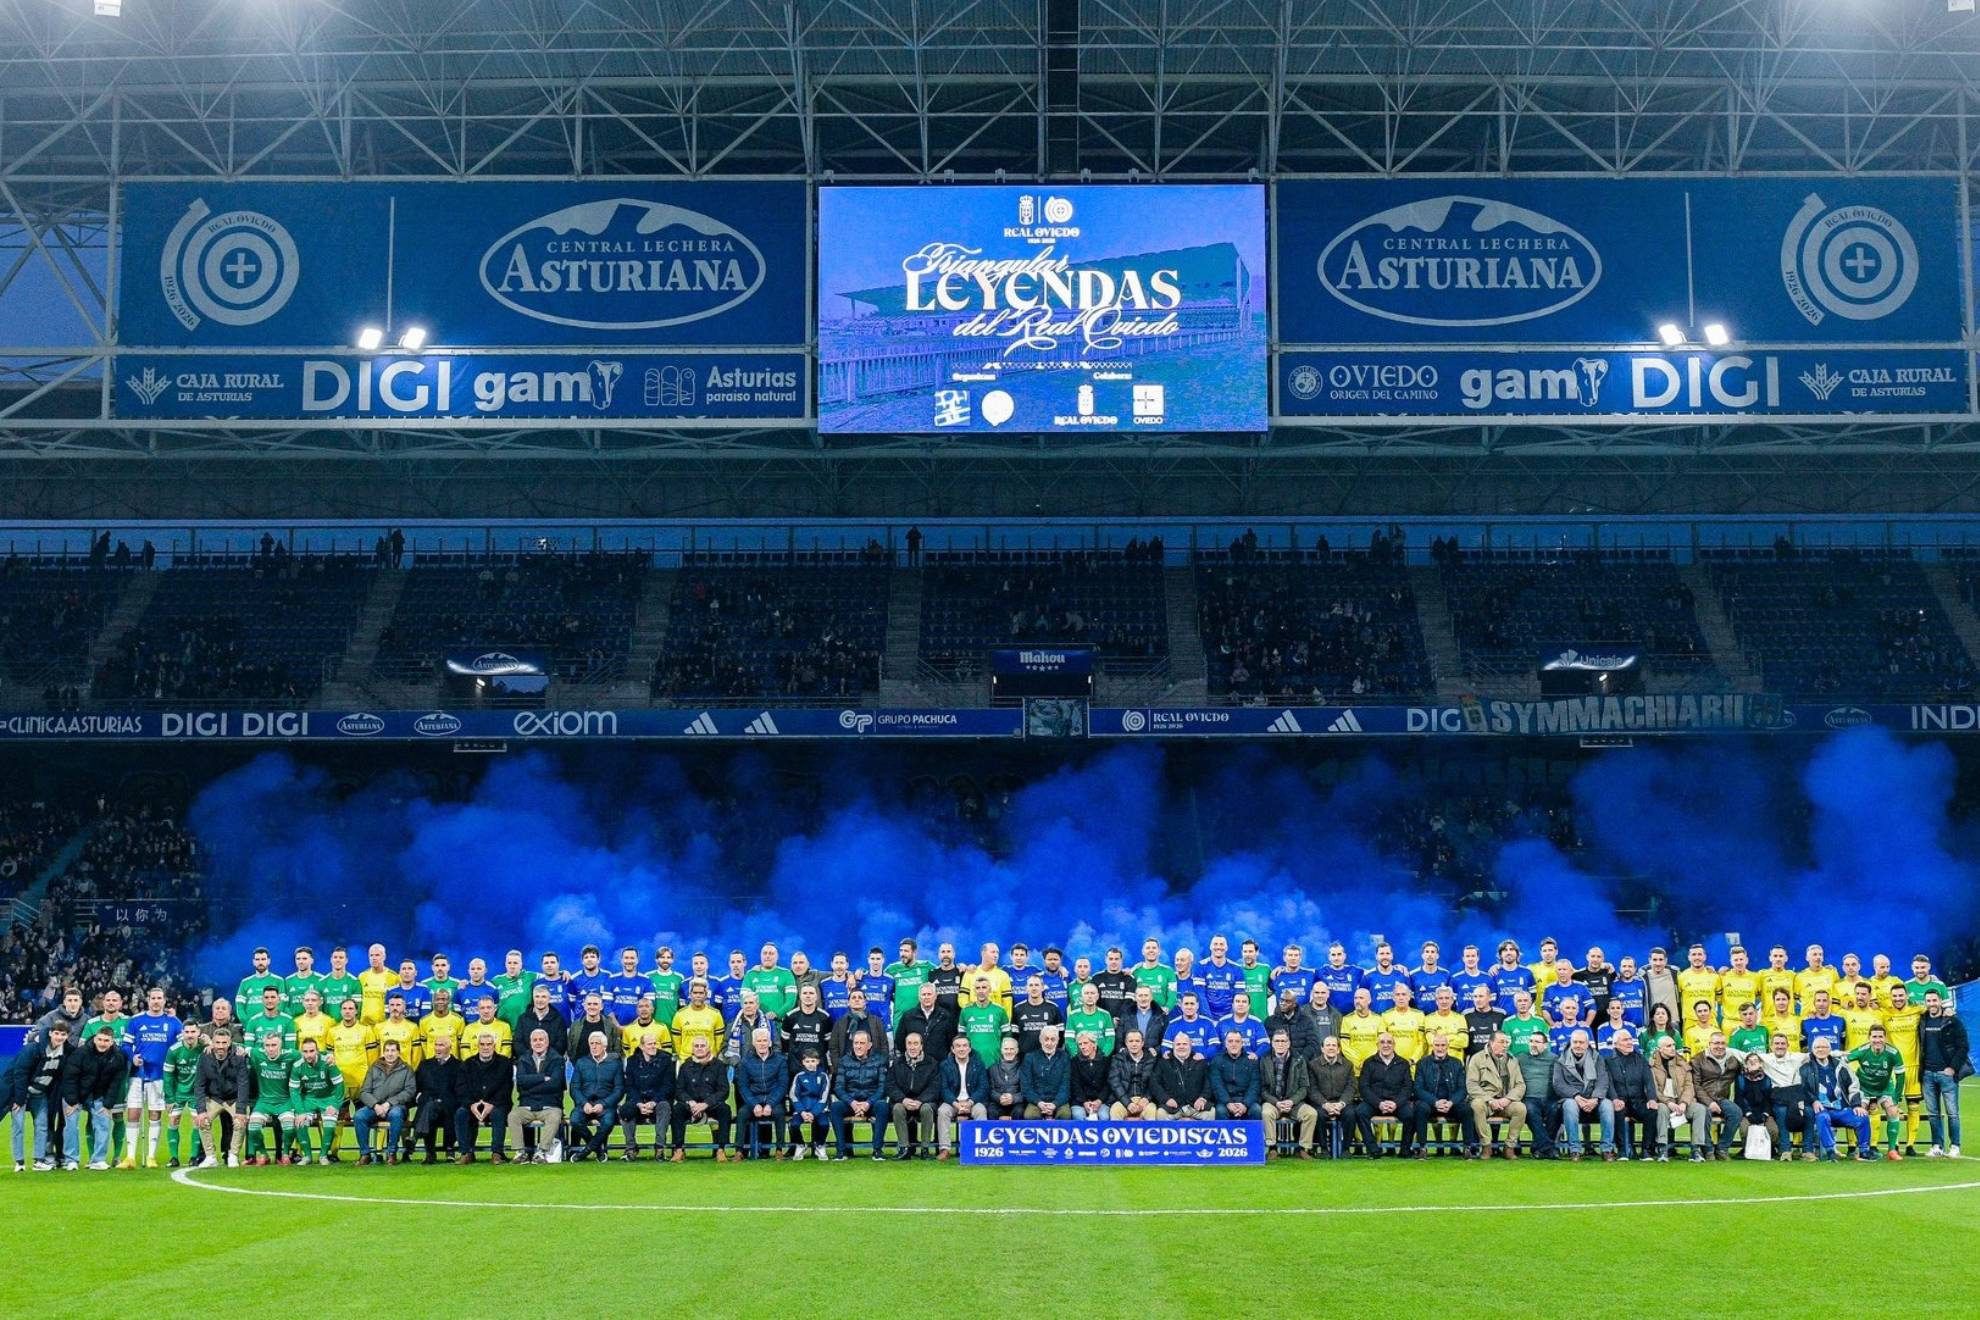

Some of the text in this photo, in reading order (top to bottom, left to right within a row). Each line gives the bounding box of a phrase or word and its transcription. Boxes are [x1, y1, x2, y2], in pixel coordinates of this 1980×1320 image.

[208, 214, 277, 233] REAL OVIEDO
[1824, 209, 1893, 229] REAL OVIEDO
[1003, 227, 1080, 237] REAL OVIEDO
[547, 240, 735, 253] CENTRAL LECHERA
[1383, 238, 1571, 250] CENTRAL LECHERA
[497, 243, 749, 293] ASTURIANA
[903, 242, 1070, 276] Triangular
[1336, 239, 1585, 290] ASTURIANA
[905, 269, 1183, 311] LEYENDAS
[173, 303, 195, 327] 2026
[1797, 298, 1819, 321] 2026
[953, 309, 1008, 337] del
[1080, 306, 1180, 355] Oviedo
[176, 373, 284, 388] CAJA RURAL
[302, 360, 451, 412] DIGI
[706, 365, 797, 388] Asturias
[1329, 365, 1439, 388] OVIEDO
[1631, 356, 1780, 408] DIGI
[1848, 367, 1957, 384] CAJA RURAL
[178, 392, 252, 401] DE ASTURIAS
[474, 371, 592, 411] gam
[754, 390, 797, 402] natural
[1330, 390, 1438, 400] ORIGEN DEL CAMINO
[1460, 369, 1578, 409] gam
[1851, 386, 1926, 397] DE ASTURIAS
[1133, 417, 1164, 425] OVIEDO
[1019, 651, 1066, 664] Mahou
[1580, 654, 1623, 667] Unicaja
[161, 712, 228, 737] DIGI
[242, 712, 309, 737] DIGI
[513, 710, 617, 736] exiom
[877, 714, 958, 725] GRUPO PACHUCA
[1153, 712, 1230, 722] REAL OVIEDO
[1406, 708, 1462, 732] DIG
[1490, 695, 1744, 733] SYMMACHIARII
[974, 1126, 1248, 1145] LEYENDAS OVIEDISTAS
[974, 1147, 1004, 1158] 1926
[1217, 1147, 1249, 1158] 2026
